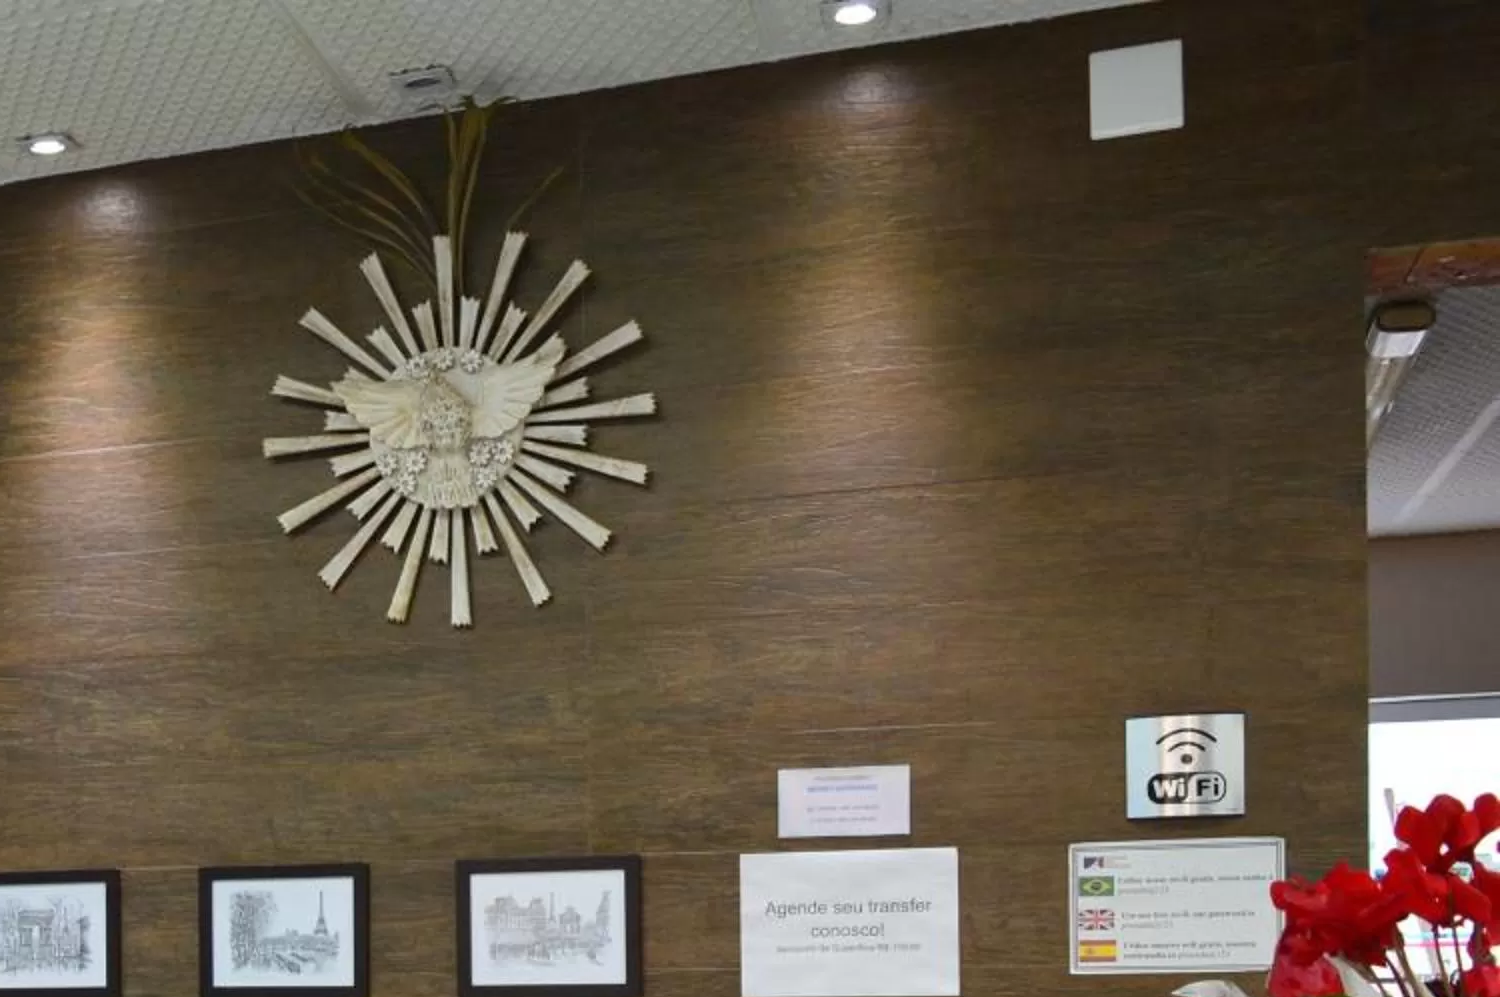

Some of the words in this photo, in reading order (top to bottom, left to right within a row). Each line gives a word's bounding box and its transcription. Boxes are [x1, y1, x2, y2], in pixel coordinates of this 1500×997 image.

[764, 900, 828, 918] Agende
[832, 901, 863, 915] seu
[868, 897, 932, 914] transfer
[810, 922, 886, 938] conosco!
